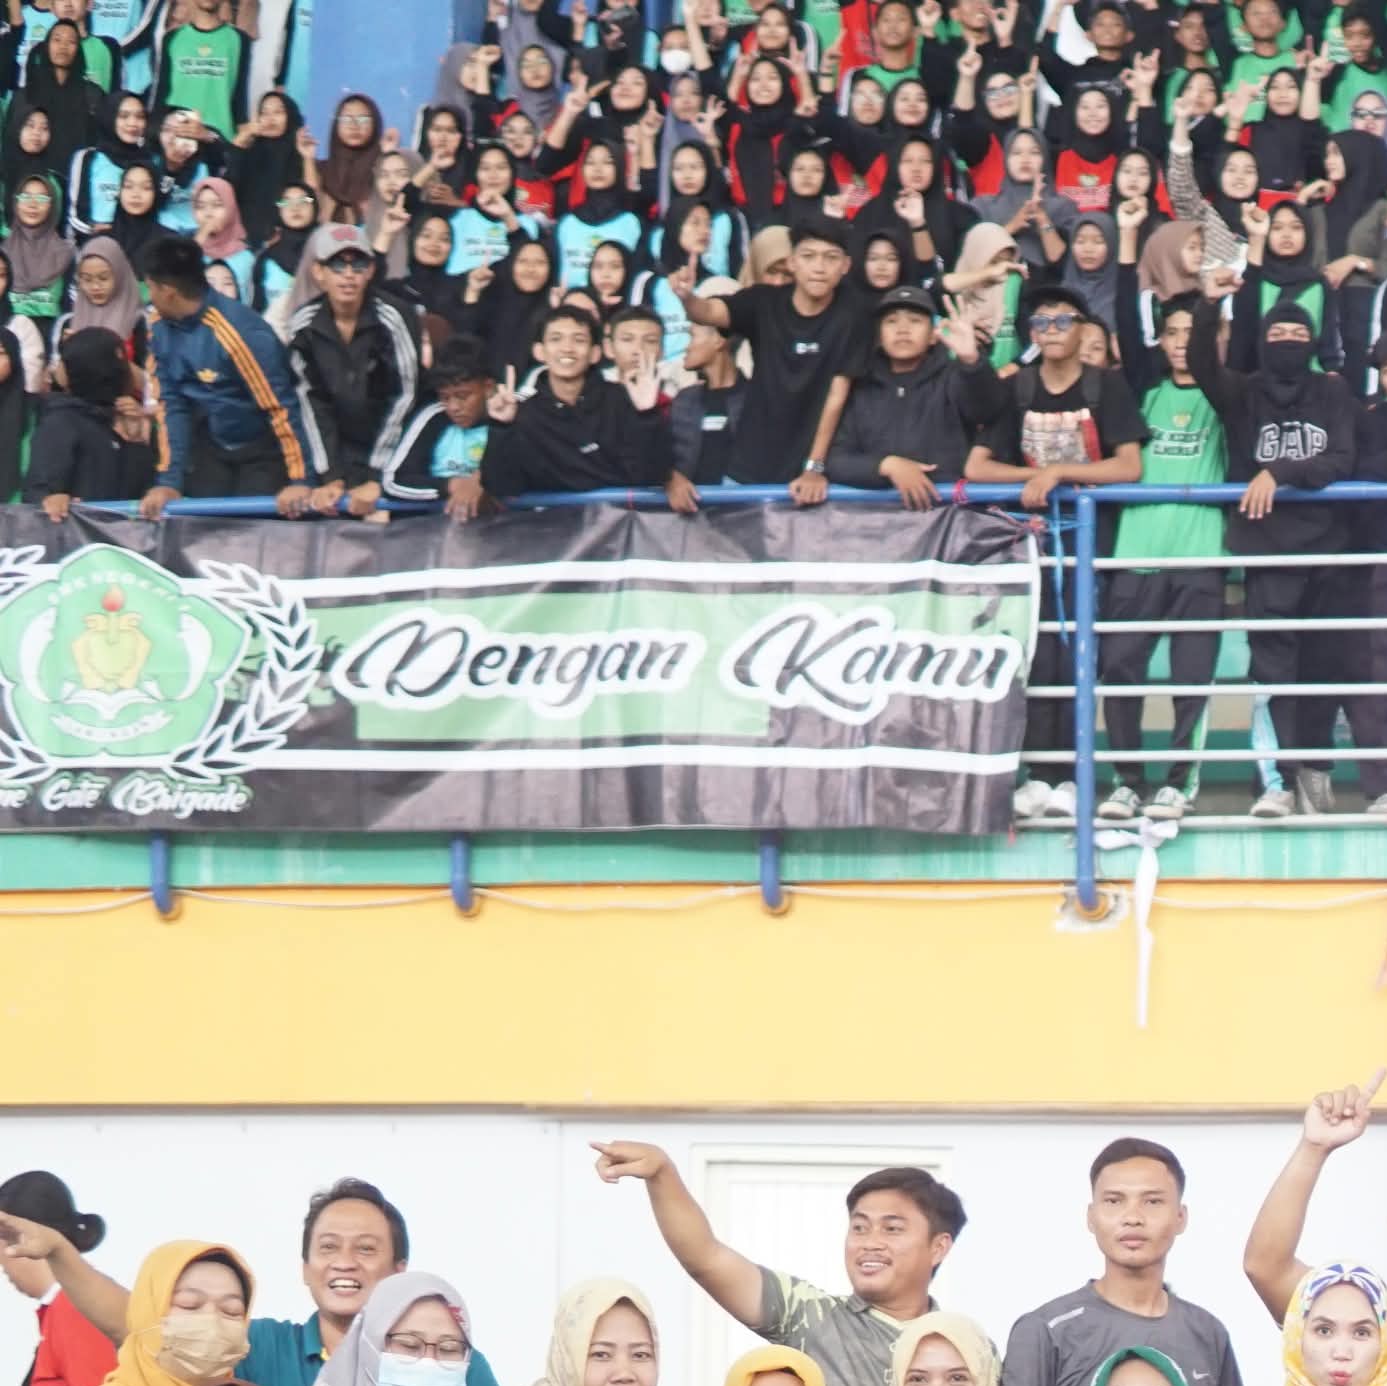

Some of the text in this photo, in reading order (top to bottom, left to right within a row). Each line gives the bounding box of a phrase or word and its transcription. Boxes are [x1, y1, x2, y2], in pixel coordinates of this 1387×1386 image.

[1256, 421, 1329, 463] GAP
[345, 612, 1012, 714] Dengan Kamu
